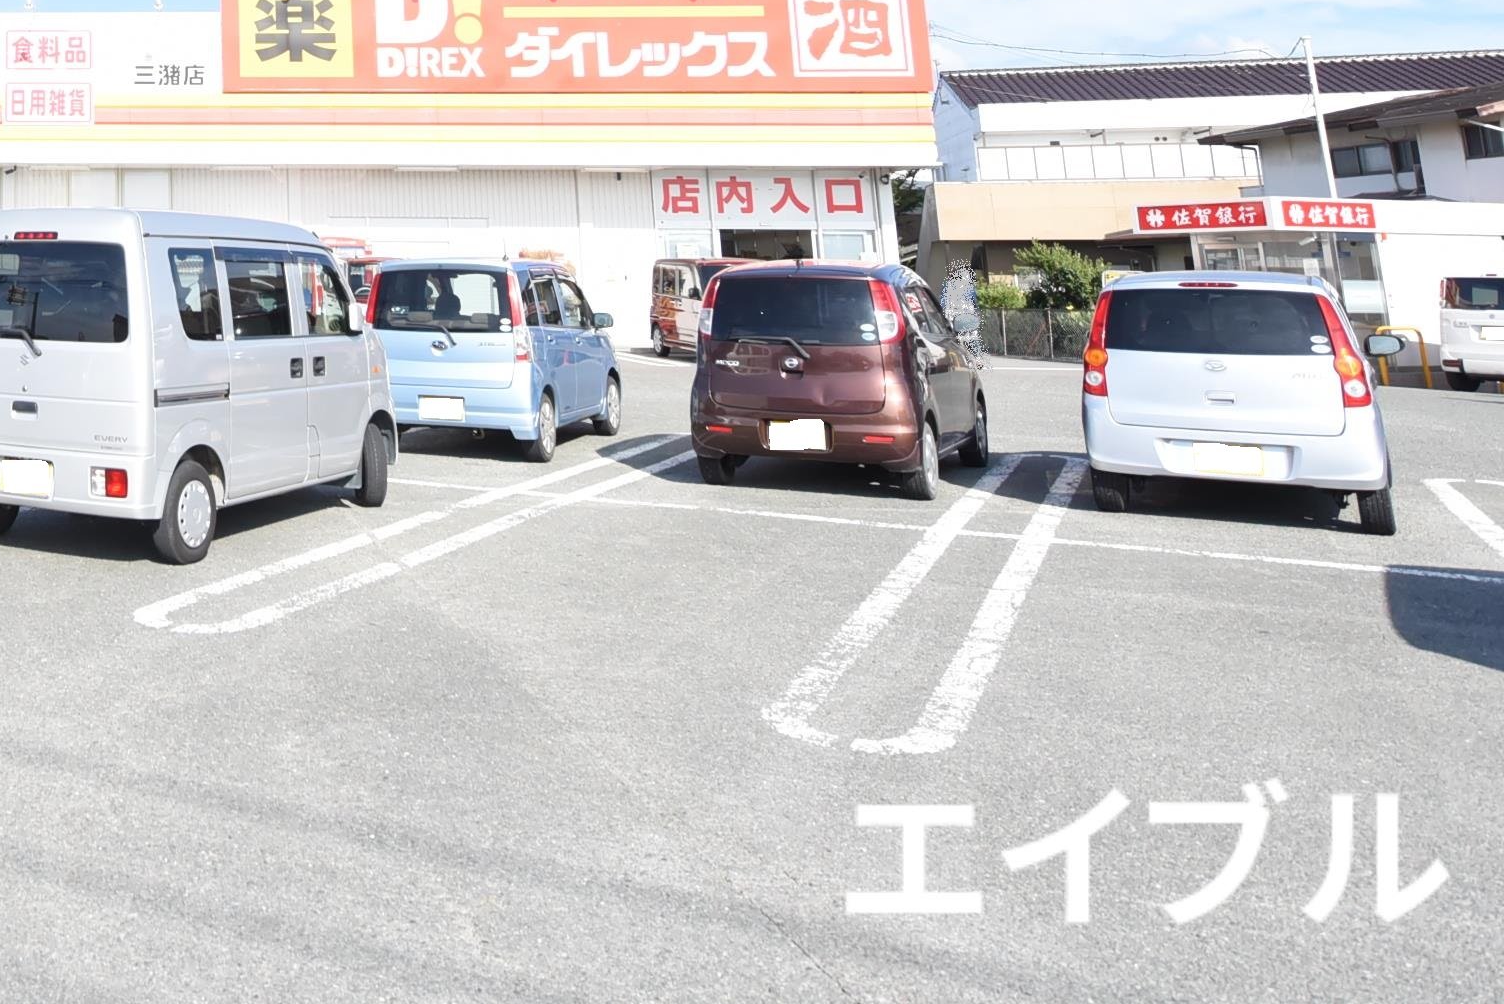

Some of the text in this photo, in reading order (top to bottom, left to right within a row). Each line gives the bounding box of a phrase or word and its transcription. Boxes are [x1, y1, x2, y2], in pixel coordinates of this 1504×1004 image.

[12, 36, 86, 64] 食料品
[504, 26, 777, 78] ダイレックス
[11, 88, 85, 116] 日用雑貨
[662, 175, 864, 215] 店内入口
[1171, 204, 1257, 227] 佐賀銀行
[1308, 204, 1370, 226] 佐賀銀行
[94, 434, 128, 444] EVERY
